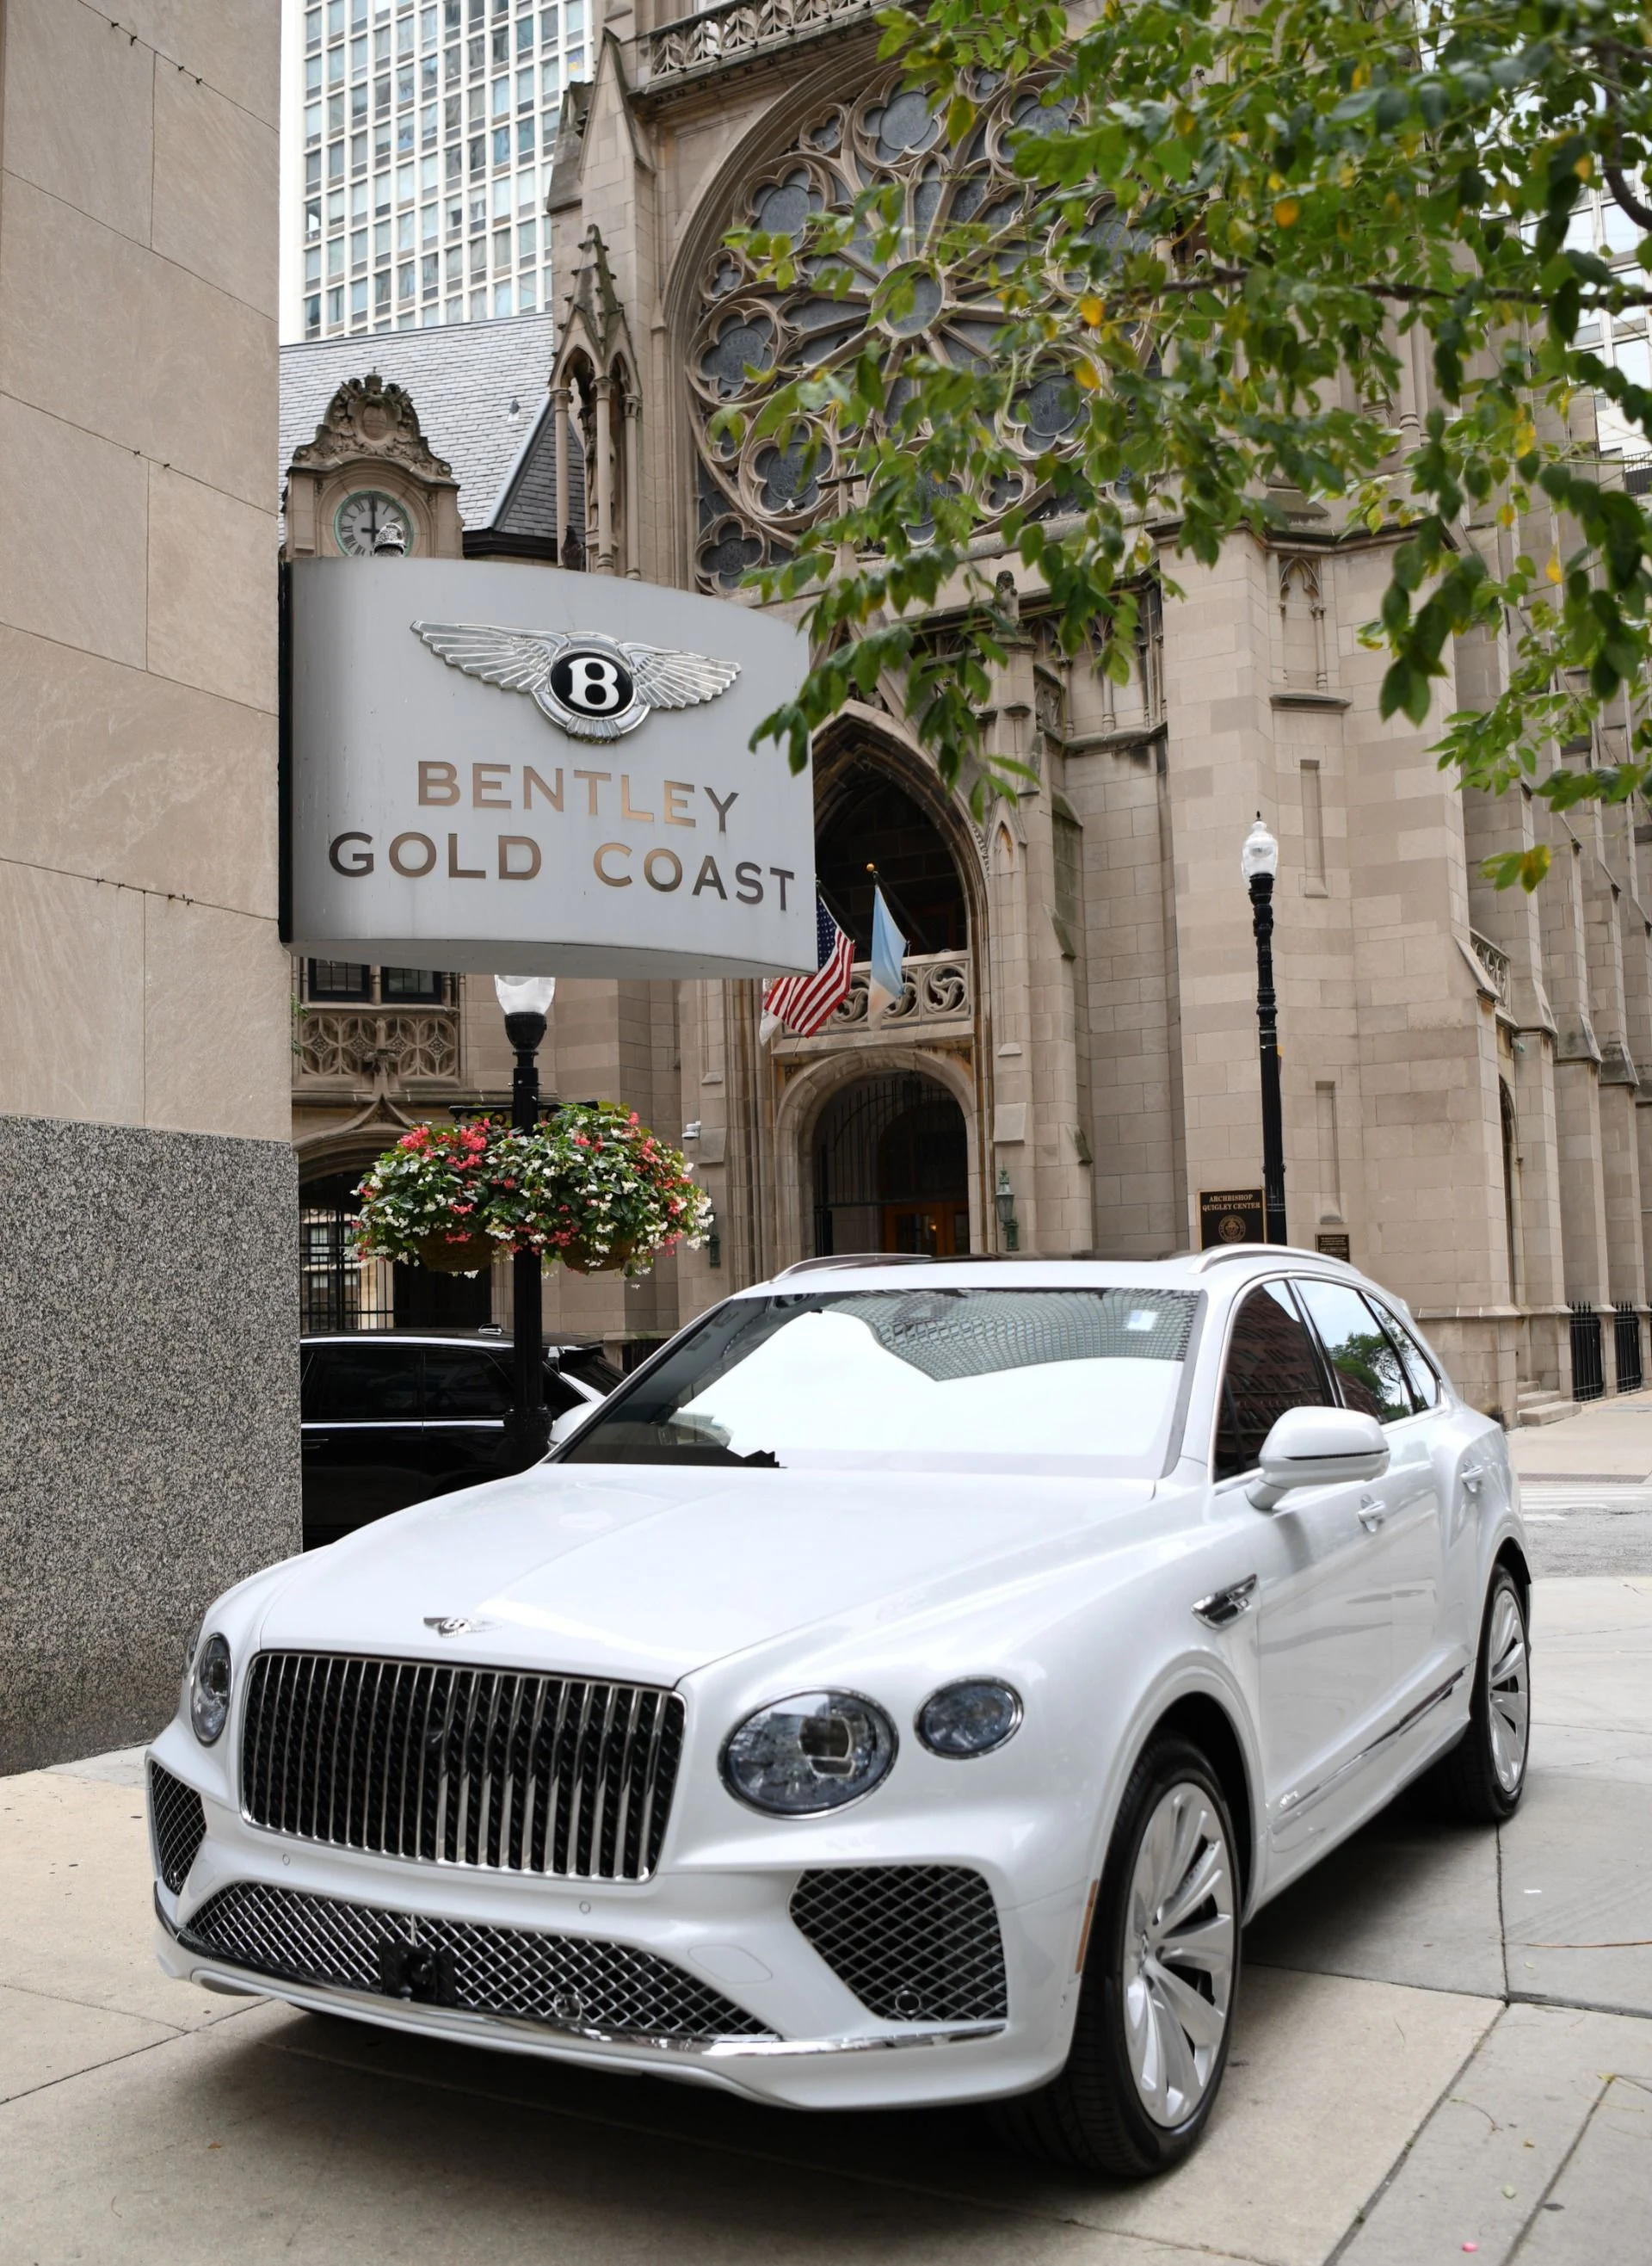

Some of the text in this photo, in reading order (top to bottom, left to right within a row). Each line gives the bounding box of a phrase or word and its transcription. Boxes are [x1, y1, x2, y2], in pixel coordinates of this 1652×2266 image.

[568, 657, 620, 711] B
[417, 761, 739, 833] BENTLEY
[329, 831, 795, 911] GOLD COAST
[1203, 1203, 1232, 1212] QUIGLEY
